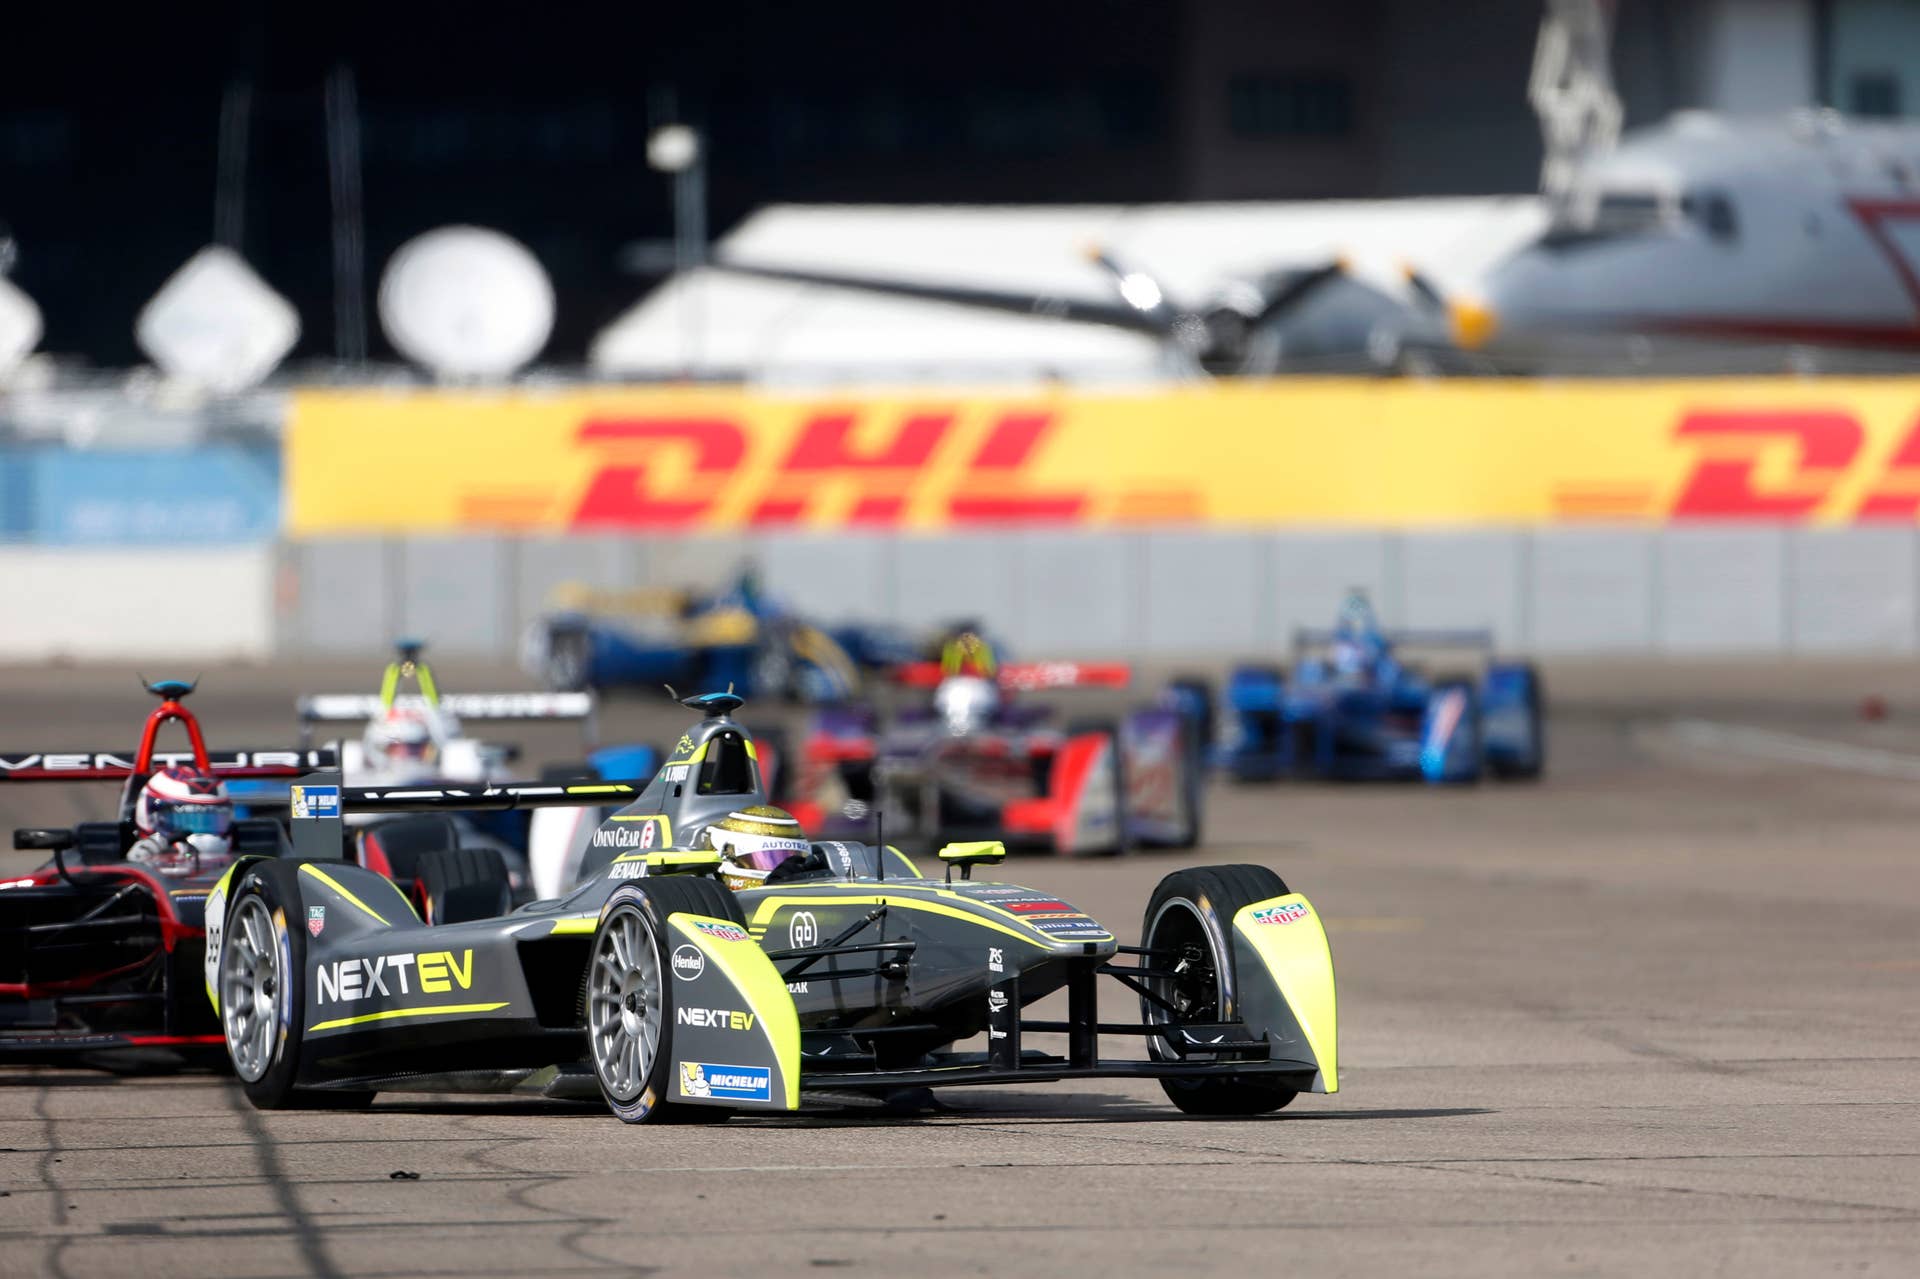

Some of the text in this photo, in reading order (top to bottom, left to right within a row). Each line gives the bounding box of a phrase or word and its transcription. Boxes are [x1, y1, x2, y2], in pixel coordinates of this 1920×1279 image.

[570, 412, 1088, 526] DHL
[615, 826, 640, 848] GEAR
[608, 861, 650, 879] RENAUL
[310, 907, 325, 918] TAG
[1252, 903, 1304, 918] TAG
[1257, 909, 1308, 925] HEUER
[675, 955, 701, 969] Henkel
[317, 949, 473, 1005] NEXTEV
[678, 1007, 754, 1031] NEXTEV
[710, 1074, 768, 1089] MICHELIN
